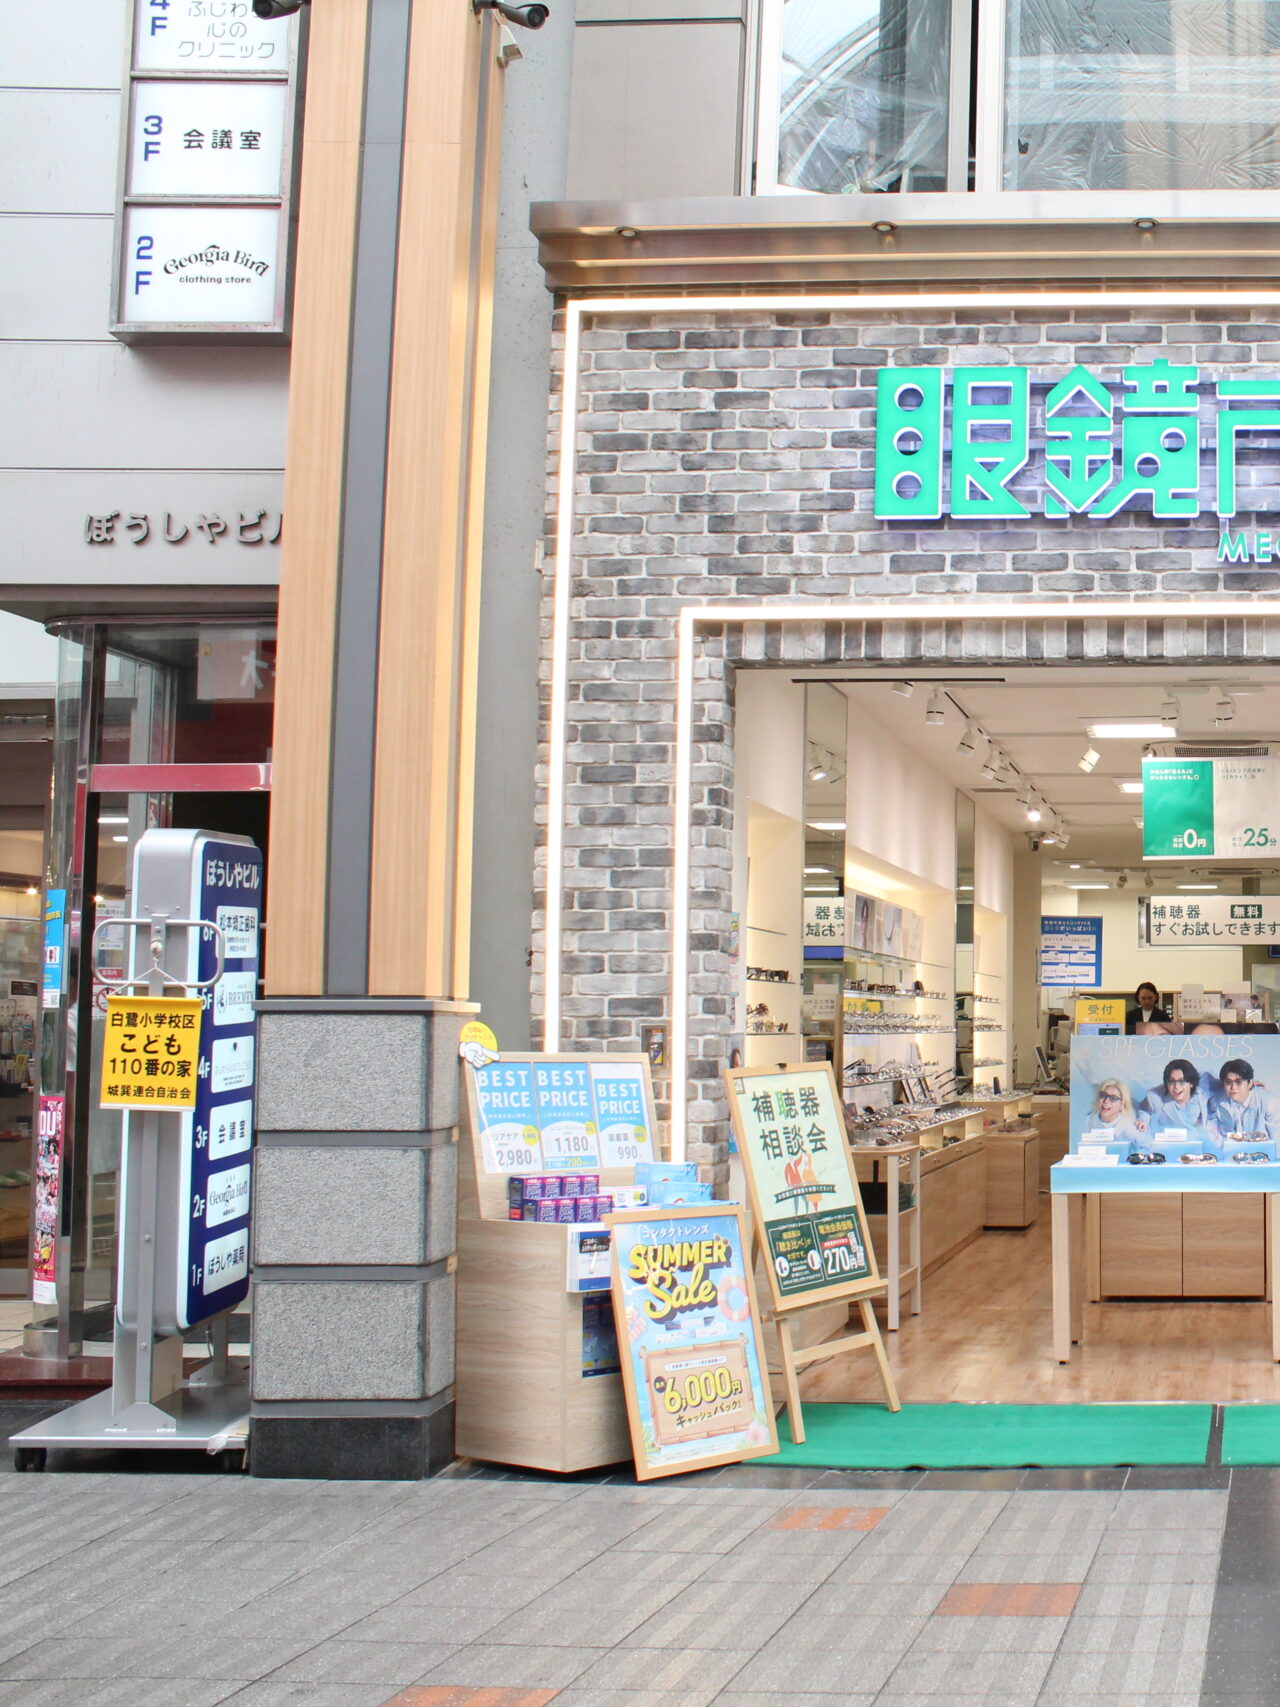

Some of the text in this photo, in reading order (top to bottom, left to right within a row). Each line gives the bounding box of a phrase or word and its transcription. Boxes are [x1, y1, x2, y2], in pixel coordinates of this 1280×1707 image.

[188, 1, 258, 18] ふじわ
[207, 22, 247, 38] 心の
[178, 41, 275, 58] クリニック
[184, 128, 261, 150] 会議室
[163, 244, 270, 277] Georgia Bird
[179, 275, 252, 285] clothing store
[1243, 827, 1278, 847] 25分
[206, 859, 260, 890] ぼうしやビル
[1152, 904, 1260, 919] 補聴器 無料
[1087, 1003, 1114, 1015] 受付
[111, 1012, 196, 1029] 白鷺小学校区
[120, 1033, 181, 1056] こども
[1098, 1035, 1254, 1059] SPF GLASSES
[110, 1058, 192, 1078] 110番の家
[198, 1055, 211, 1081] 4F
[537, 1069, 586, 1086] BEST
[478, 1070, 529, 1087] BEST
[107, 1084, 191, 1099] 城巽連合自治会
[479, 1091, 532, 1108] PRICE
[539, 1090, 589, 1107] PRICE
[597, 1083, 638, 1098] BEST
[600, 1100, 641, 1114] PRICE
[752, 1086, 820, 1123] 補聴器
[195, 1124, 208, 1149] 3F
[554, 1135, 589, 1154] 1,180
[760, 1122, 828, 1160] 相談会
[496, 1149, 532, 1168] 2,980
[617, 1146, 638, 1160] 990
[192, 1193, 205, 1218] 2F
[642, 1223, 711, 1239] コンタクトレンズ
[207, 1245, 245, 1276] ぼうしや薬局
[628, 1239, 730, 1279] SUMMER
[192, 1263, 203, 1287] 1F
[643, 1261, 718, 1320] Sale
[664, 1366, 743, 1414] 6,000円
[676, 1400, 742, 1429] キャッシュバック!
